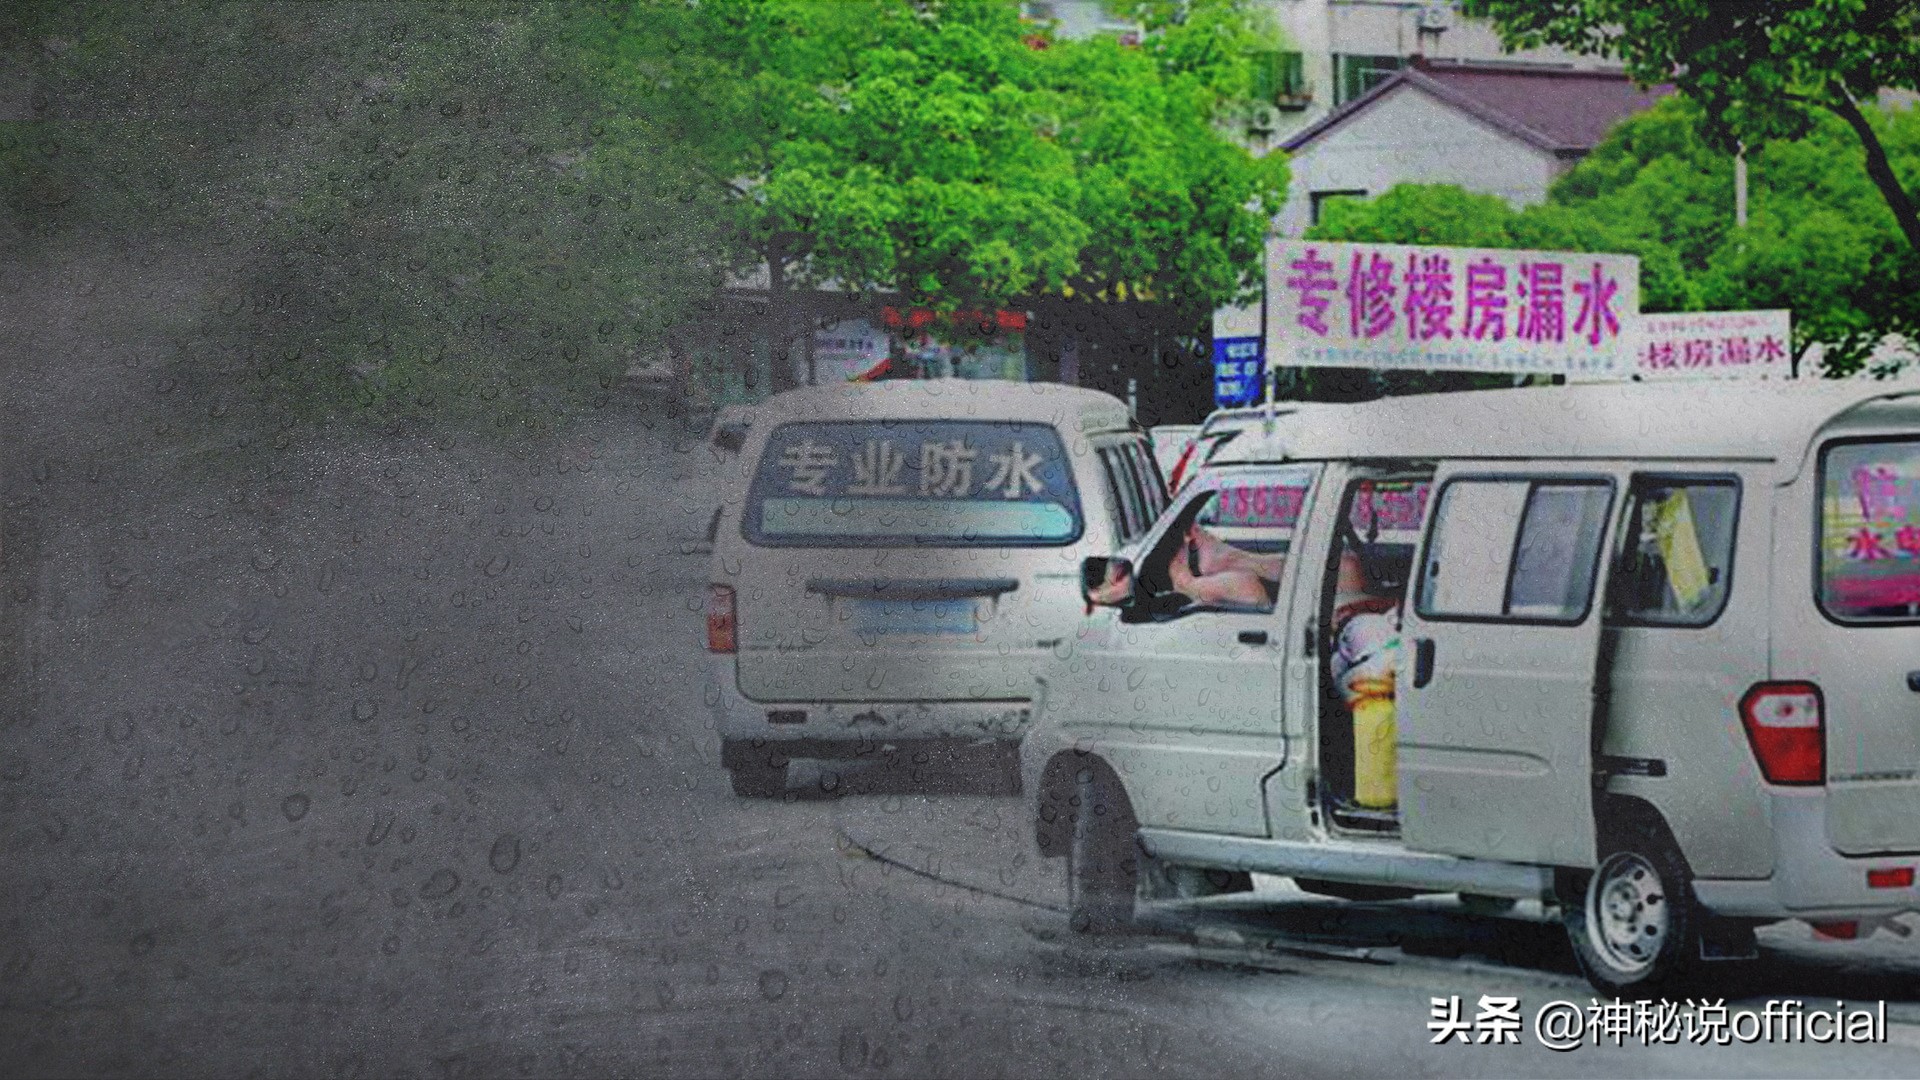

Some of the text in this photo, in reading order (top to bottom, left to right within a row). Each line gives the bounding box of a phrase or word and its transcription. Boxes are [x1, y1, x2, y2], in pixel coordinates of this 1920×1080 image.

[1287, 248, 1621, 346] 专修楼房漏水
[1638, 334, 1785, 370] 楼房漏水
[779, 440, 1044, 498] 专业防水
